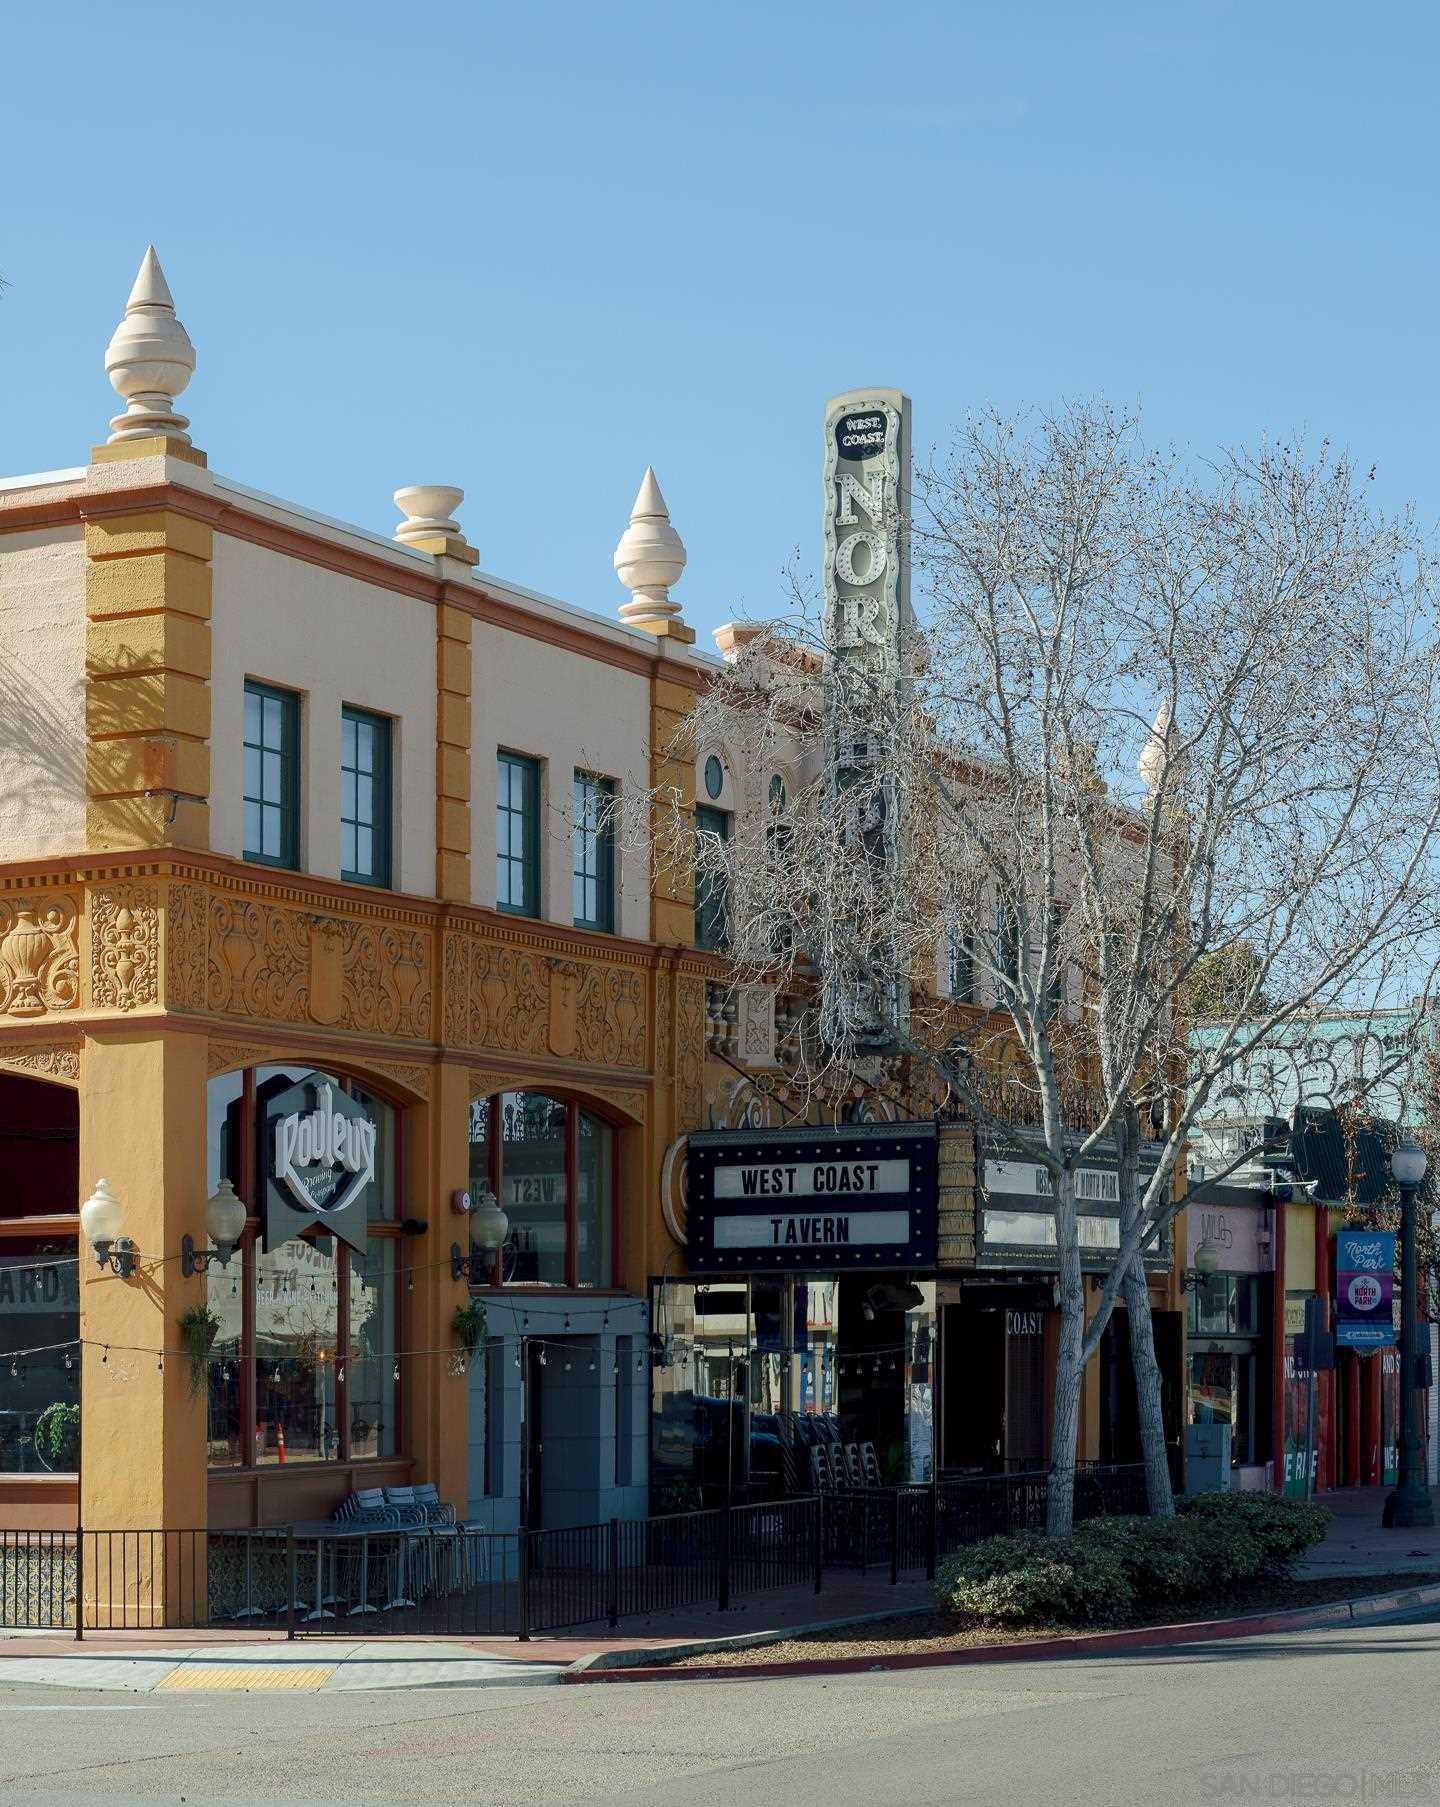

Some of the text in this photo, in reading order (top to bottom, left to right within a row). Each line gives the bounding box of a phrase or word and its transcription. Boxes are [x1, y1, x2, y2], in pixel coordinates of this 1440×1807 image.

[741, 1165, 879, 1195] WEST COAST
[770, 1216, 849, 1244] TAVERN
[1007, 1312, 1042, 1335] COAST
[1295, 1449, 1318, 1480] RIE
